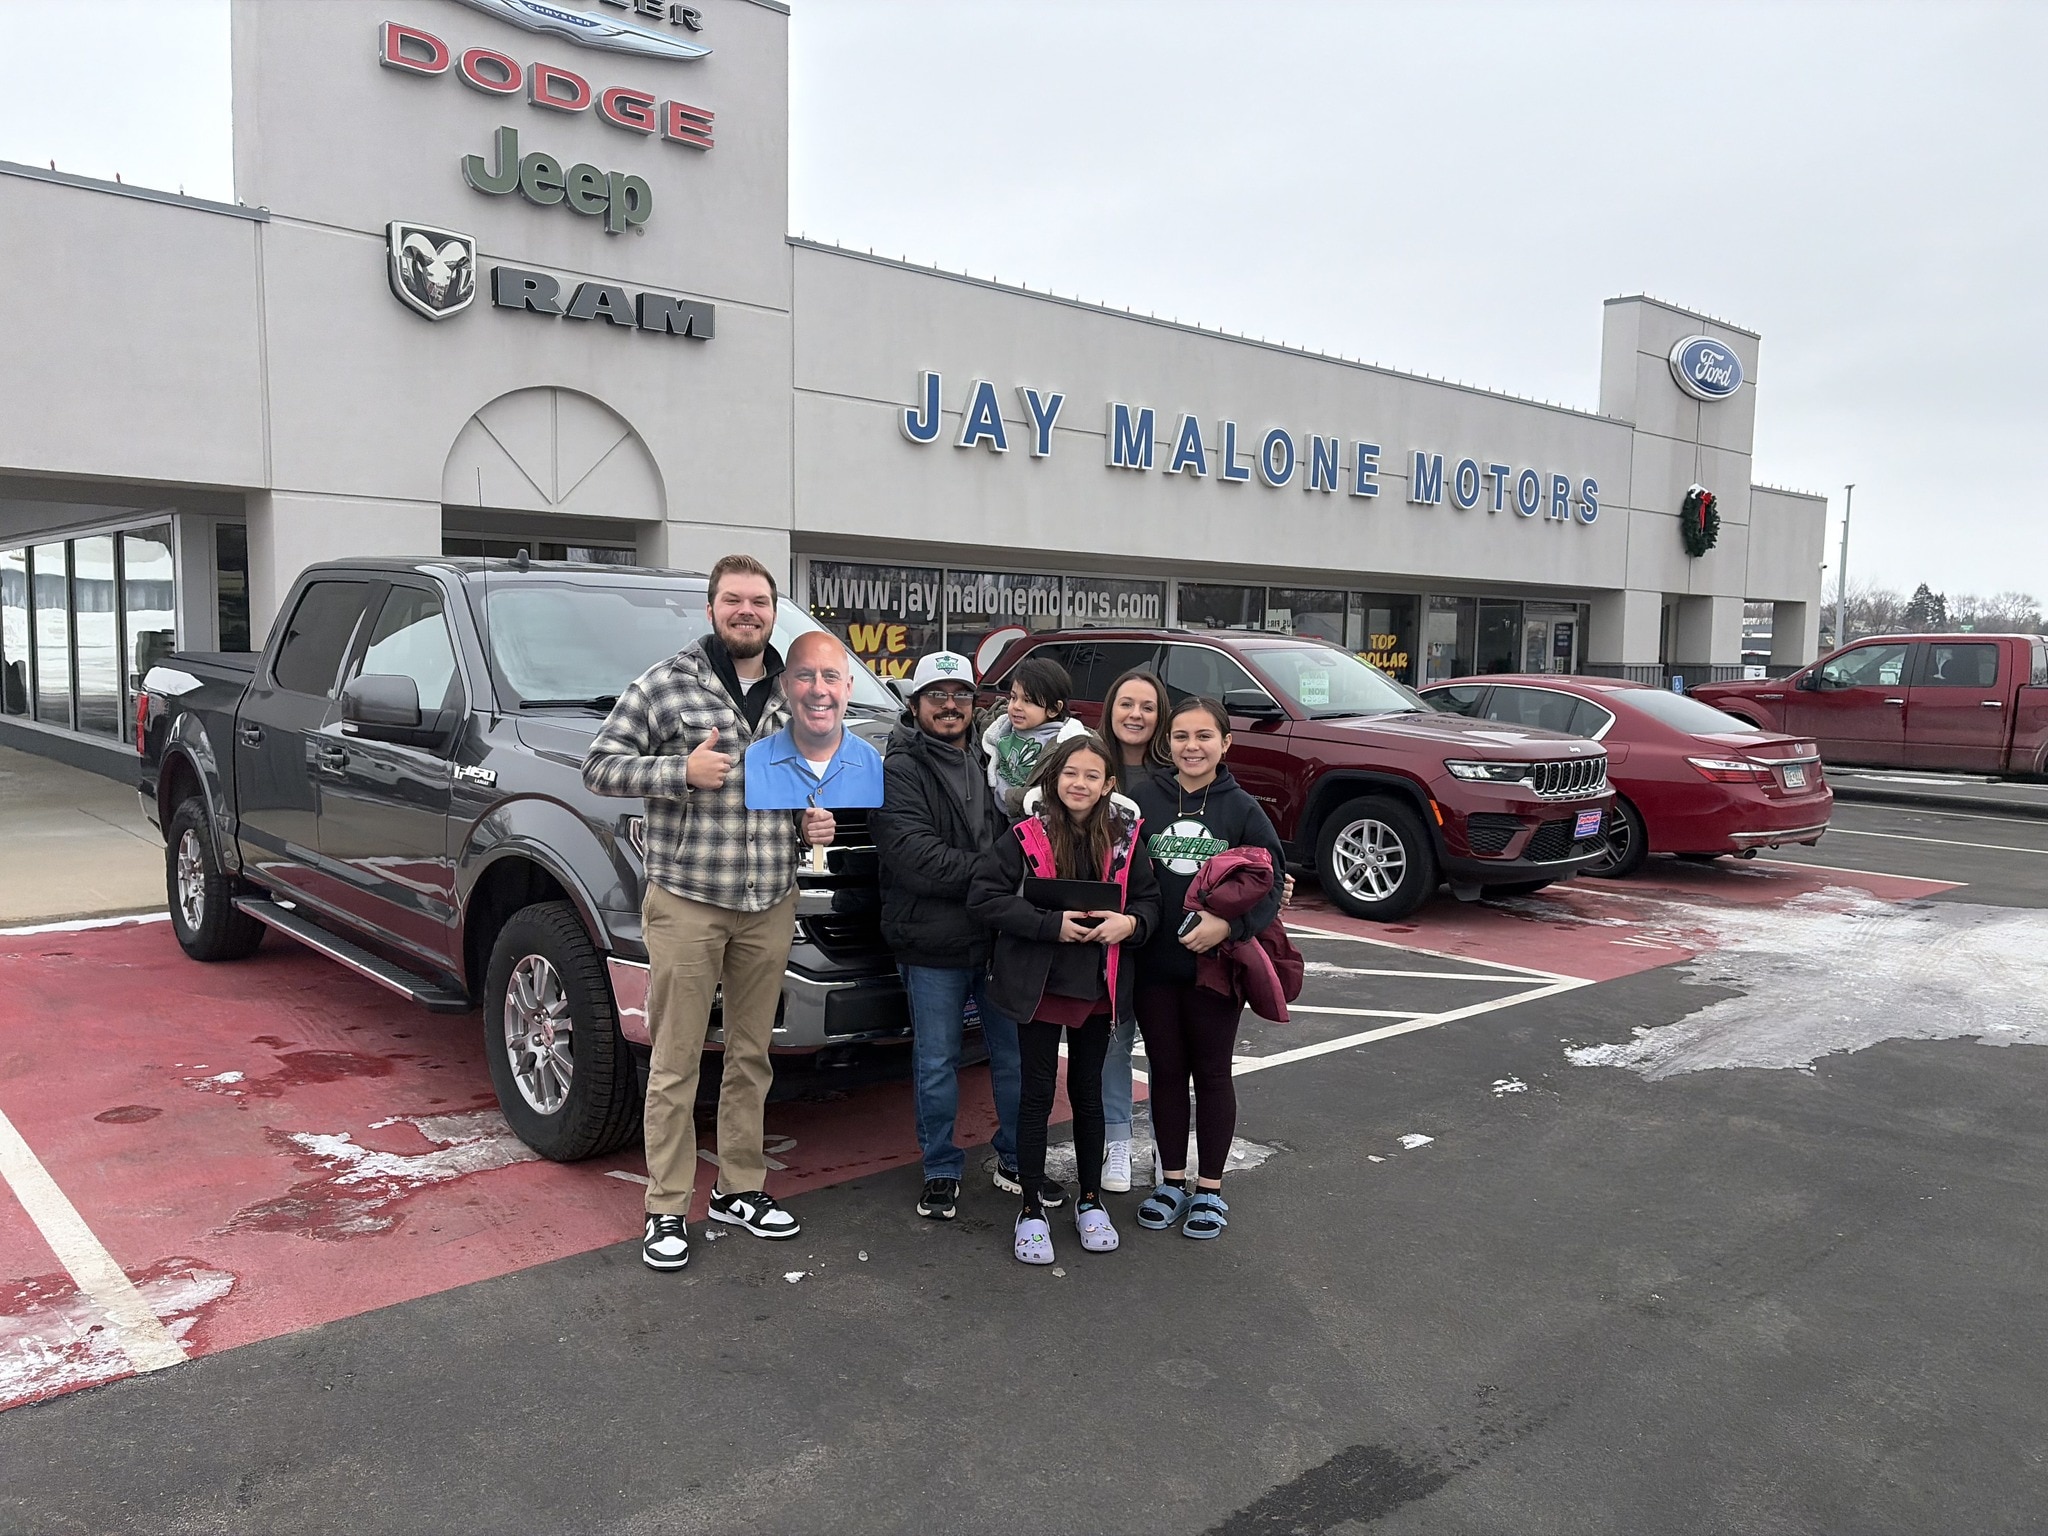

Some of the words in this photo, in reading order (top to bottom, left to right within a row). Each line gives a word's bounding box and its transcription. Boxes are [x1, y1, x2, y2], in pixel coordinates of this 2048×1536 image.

[527, 3, 592, 27] CHRYSLER
[379, 20, 715, 150] DODGE
[461, 125, 653, 235] Jeep
[491, 265, 715, 340] RAM
[1695, 349, 1733, 387] Ford
[899, 370, 1066, 457] JAY
[1105, 402, 1381, 497] MALONE
[1407, 449, 1599, 525] MOTORS
[848, 623, 907, 652] WE
[1370, 634, 1397, 650] TOP
[866, 658, 913, 679] UY
[1147, 834, 1229, 859] LITCHFIELD
